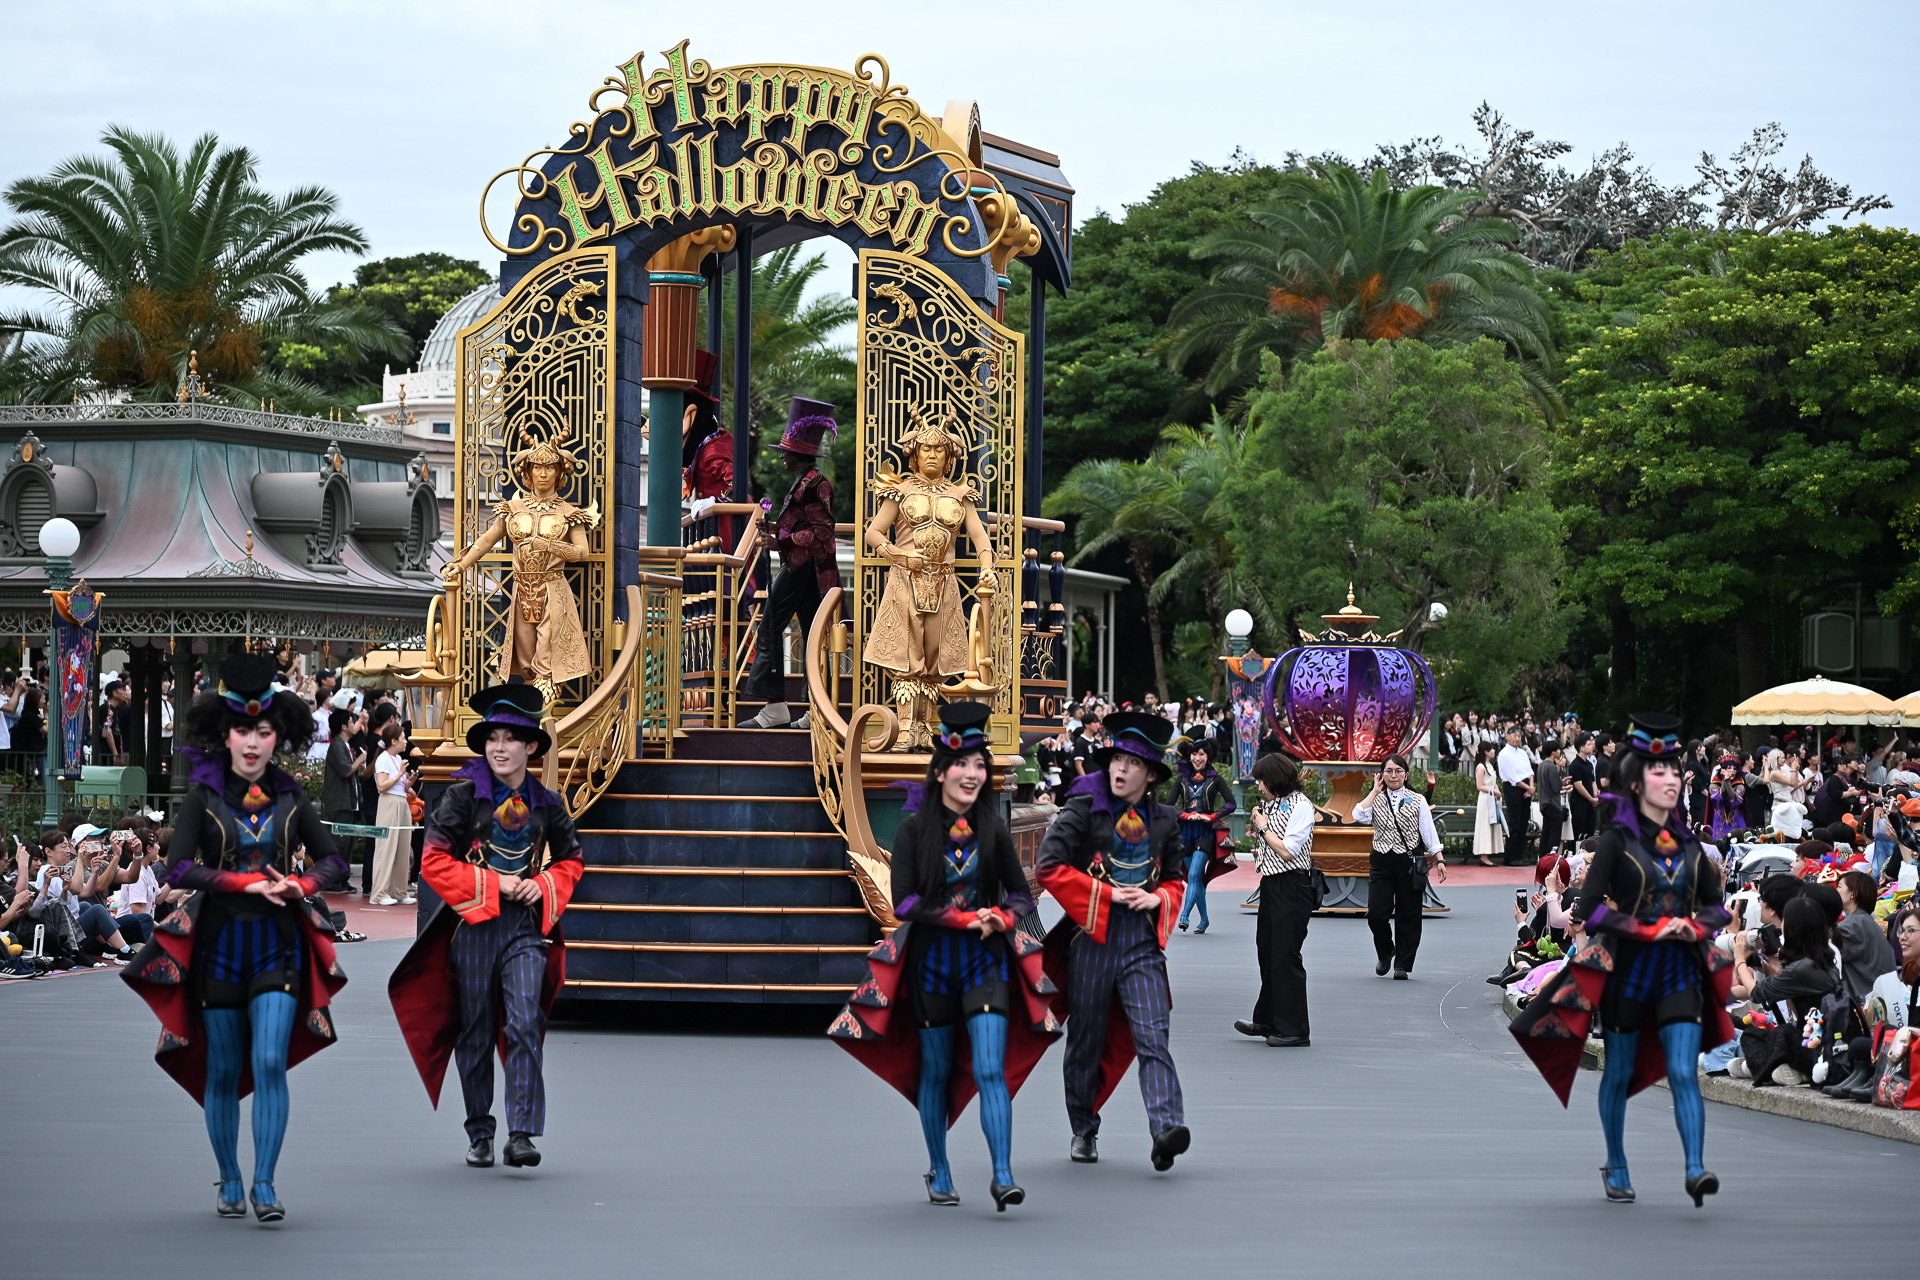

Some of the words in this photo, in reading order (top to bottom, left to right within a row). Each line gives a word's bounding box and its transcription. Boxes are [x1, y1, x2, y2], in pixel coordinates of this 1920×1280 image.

[614, 38, 880, 166] Happy
[549, 130, 950, 256] Halloween
[1892, 1001, 1905, 1029] TOKYO
